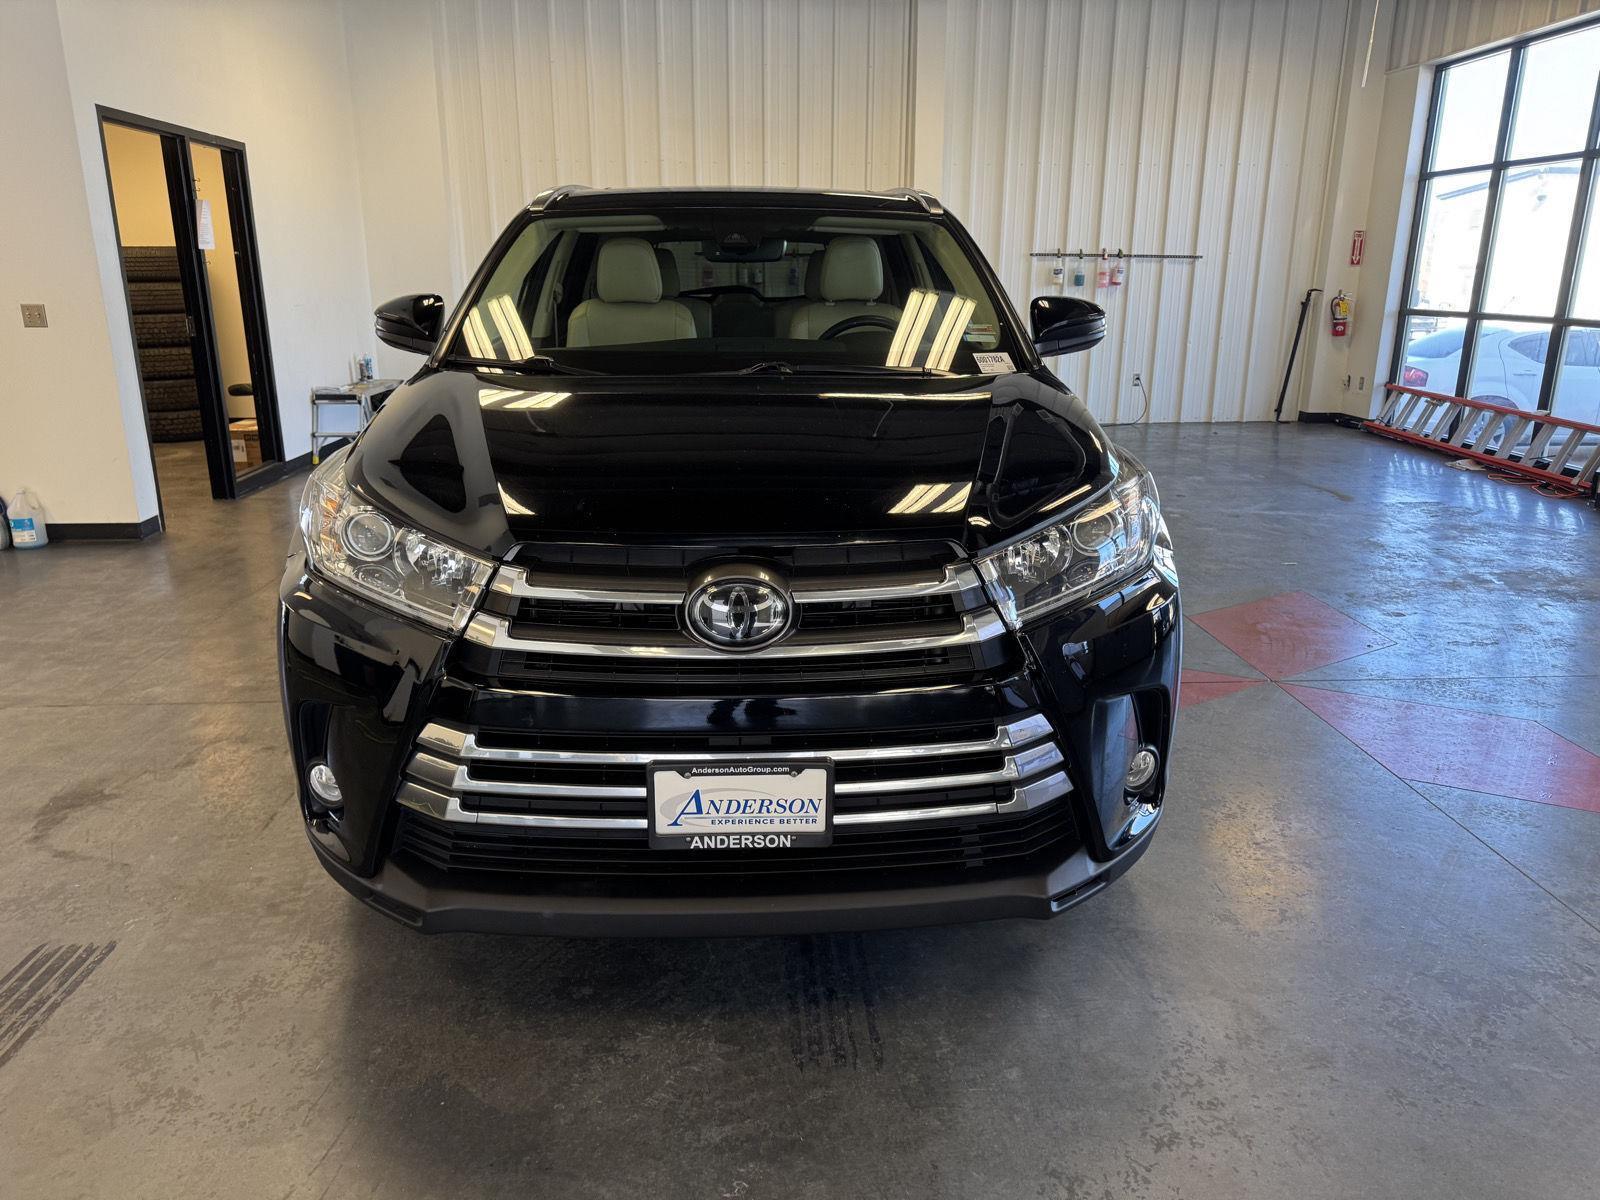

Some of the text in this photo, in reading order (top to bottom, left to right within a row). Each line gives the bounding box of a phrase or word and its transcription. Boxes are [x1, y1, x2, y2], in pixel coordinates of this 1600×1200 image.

[691, 766, 790, 775] AndersonAutoGroup.com
[667, 788, 823, 827] ANDERSON
[690, 835, 791, 849] ANDERSON
